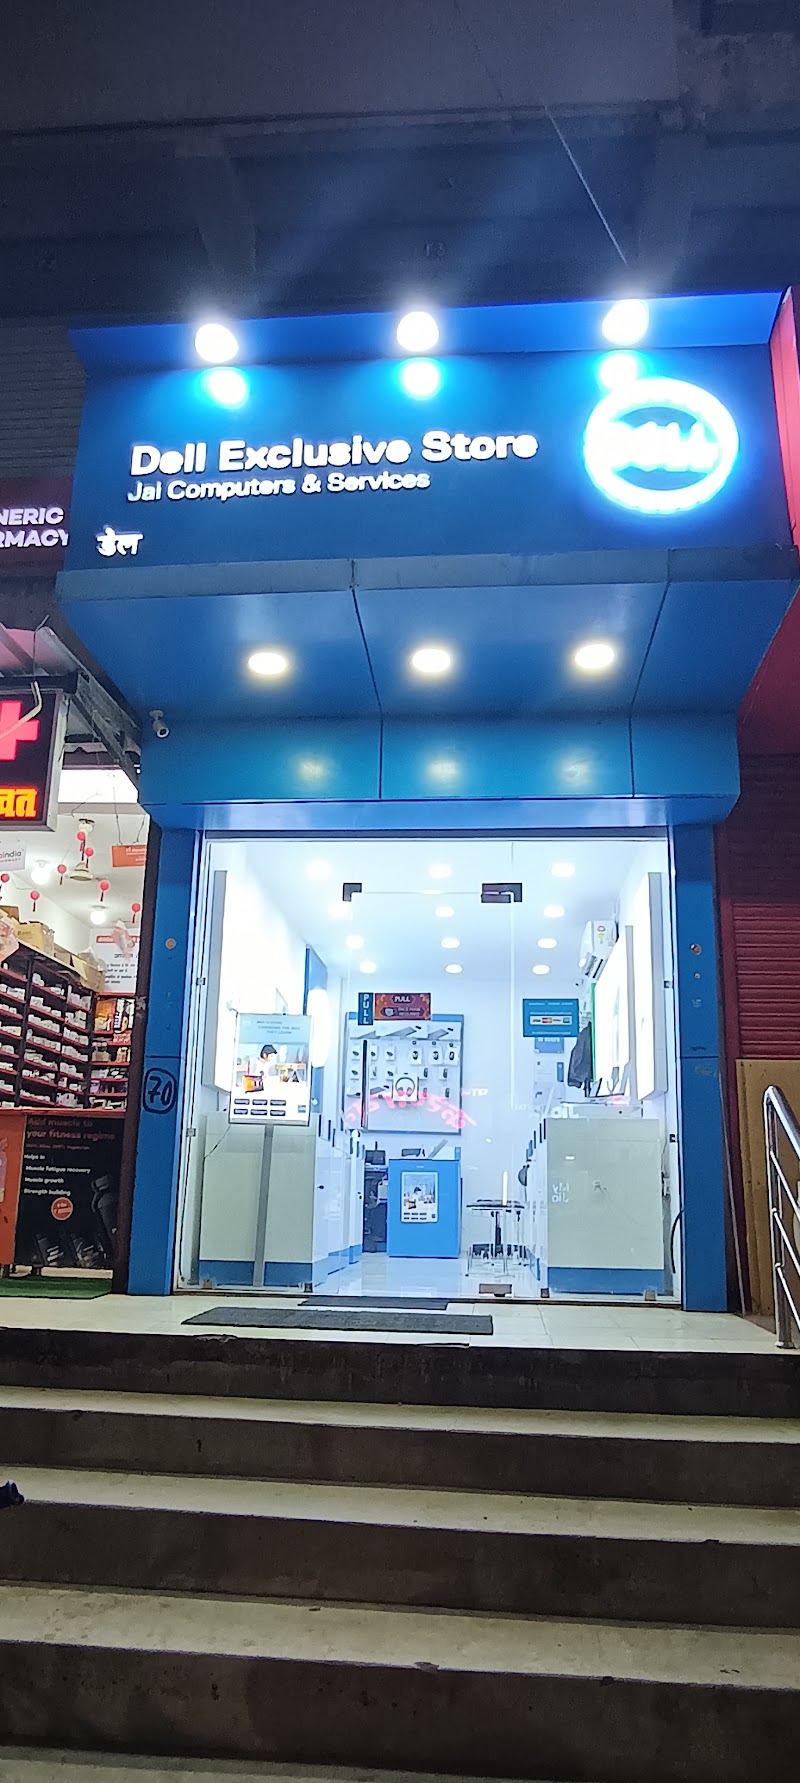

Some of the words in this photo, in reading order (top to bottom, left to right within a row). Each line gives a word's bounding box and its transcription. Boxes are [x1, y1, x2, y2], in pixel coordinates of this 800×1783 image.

[130, 443, 207, 475] Dell
[219, 435, 411, 474] Exclusive
[422, 430, 539, 462] Store
[128, 481, 162, 501] Jai
[168, 478, 296, 501] Computers
[302, 474, 321, 493] &
[328, 470, 431, 492] Services
[96, 525, 144, 556] डेल
[148, 1076, 172, 1106] 70
[26, 1130, 47, 1139] your
[49, 1129, 81, 1139] fitness
[83, 1132, 115, 1141] regime
[48, 1119, 81, 1127] muscle
[23, 1188, 48, 1196] Strength
[48, 1189, 71, 1197] building
